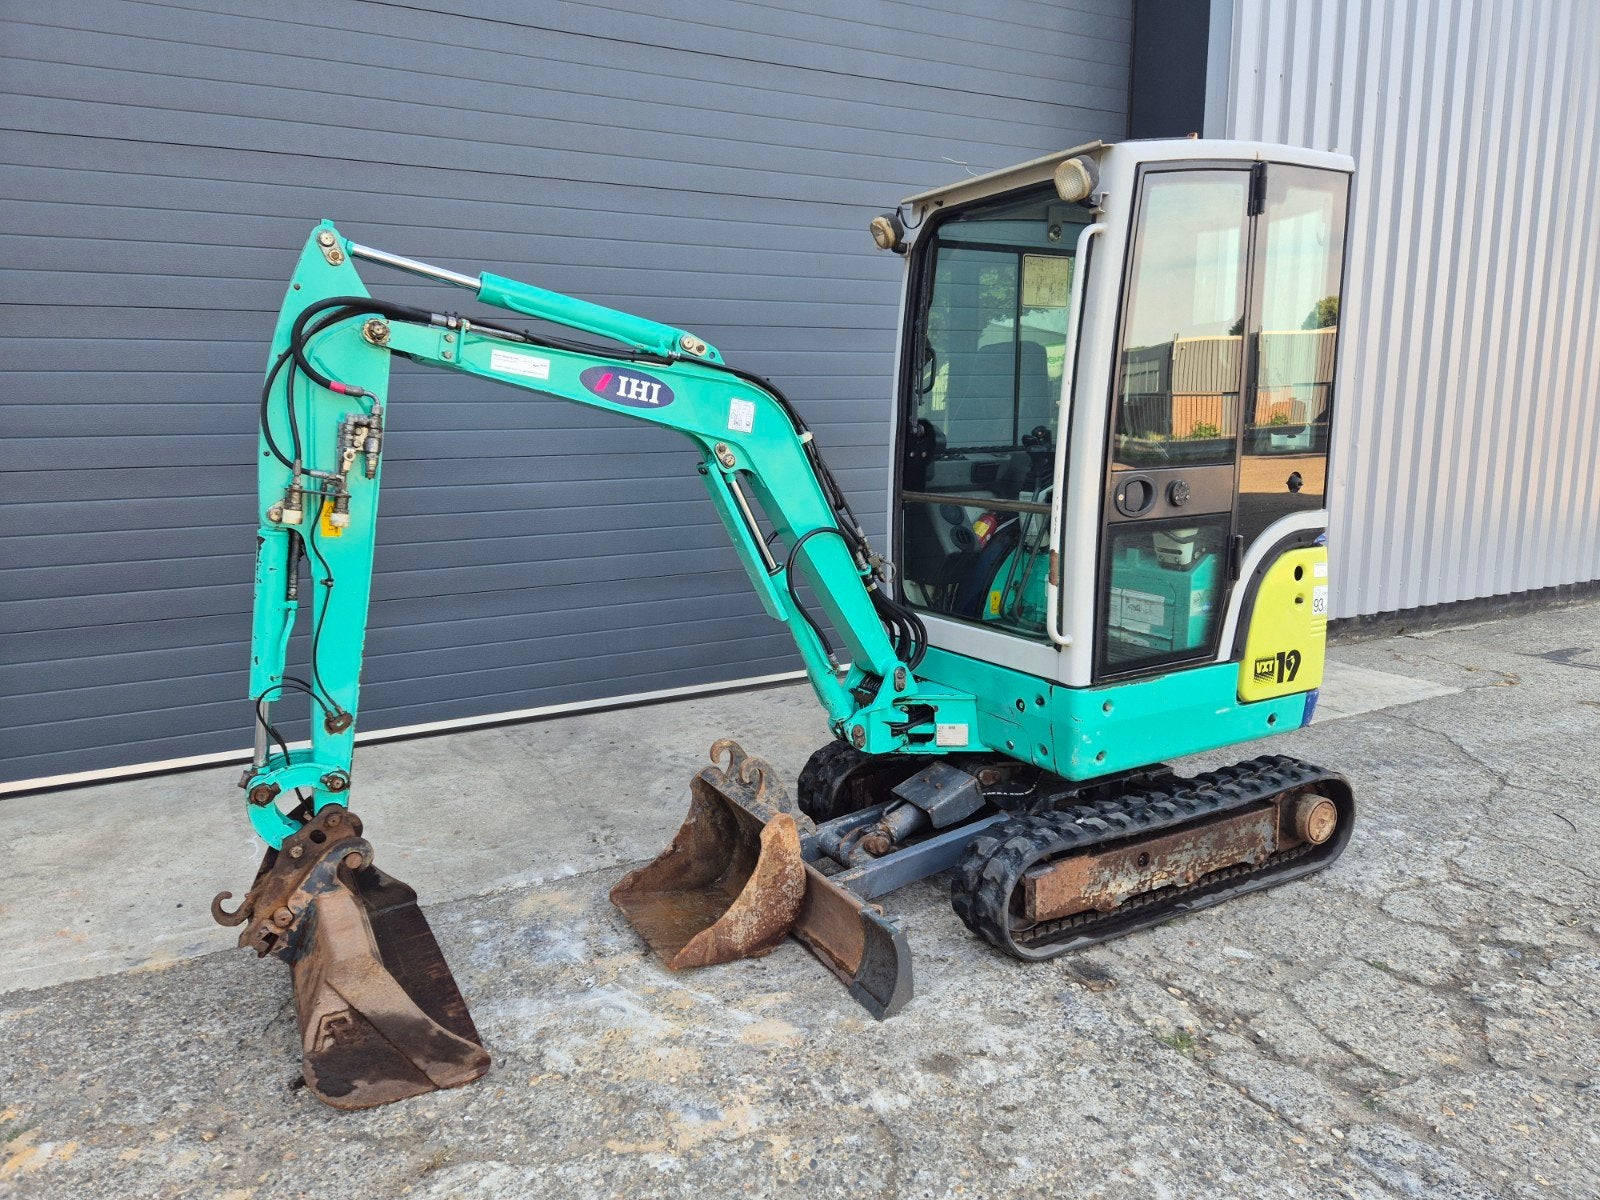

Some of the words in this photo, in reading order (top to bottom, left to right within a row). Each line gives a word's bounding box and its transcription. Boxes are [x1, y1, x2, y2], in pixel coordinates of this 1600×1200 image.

[616, 375, 662, 404] IHI
[1256, 659, 1274, 674] VXT
[1276, 649, 1302, 684] 19
